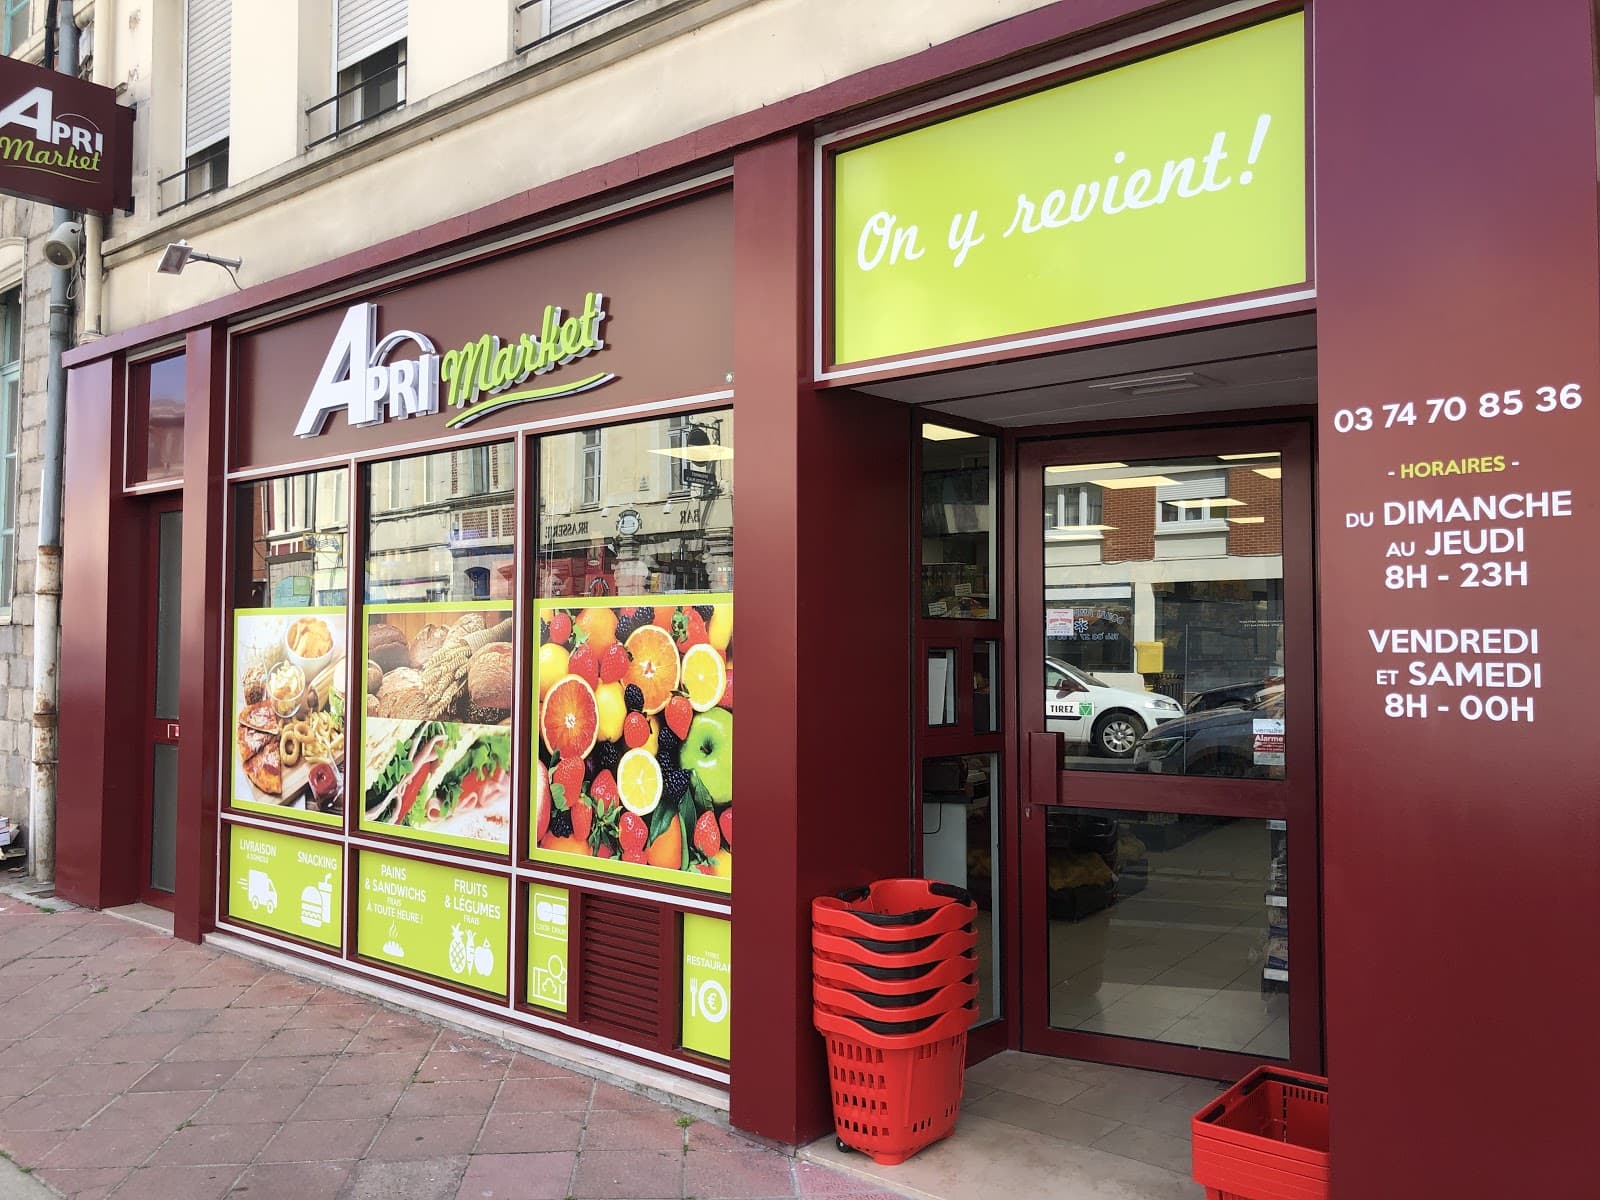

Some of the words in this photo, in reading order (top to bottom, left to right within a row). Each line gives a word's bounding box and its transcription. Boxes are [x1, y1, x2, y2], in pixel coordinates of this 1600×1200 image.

[0, 86, 103, 156] APRI
[0, 137, 101, 171] Market
[857, 211, 925, 271] On
[948, 210, 984, 268] y
[294, 302, 439, 438] APRI
[441, 292, 605, 408] Market
[1334, 407, 1373, 433] 03
[1382, 402, 1417, 428] 74
[1426, 396, 1467, 423] 70
[1479, 390, 1523, 418] 85
[1536, 383, 1582, 412] 36
[1400, 455, 1506, 479] HORAIRES
[1346, 512, 1374, 528] DU
[1384, 490, 1572, 526] DIMANCHE
[1386, 541, 1415, 558] AU
[1425, 527, 1524, 556] JEUDI
[1385, 564, 1427, 589] 8H
[1460, 561, 1528, 588] 23H
[1368, 628, 1538, 654] VENDREDI
[1376, 669, 1399, 685] ET
[1409, 661, 1541, 689] SAMEDI
[1050, 705, 1074, 713] TIREZ
[1385, 693, 1427, 718] 8H
[1460, 695, 1534, 722] 00H
[1255, 734, 1284, 742] Alarme
[240, 839, 277, 857] LIVRAISON
[297, 851, 337, 870] SNACKING
[381, 864, 407, 881] PAINS
[364, 878, 371, 890] &
[372, 879, 427, 903] SANDWICHS
[454, 879, 488, 898] FRUITS
[374, 904, 396, 918] TOUTE
[397, 910, 419, 924] HEURE
[444, 896, 451, 908] &
[453, 895, 501, 920] LÉGUMES
[463, 915, 480, 925] FRAIS
